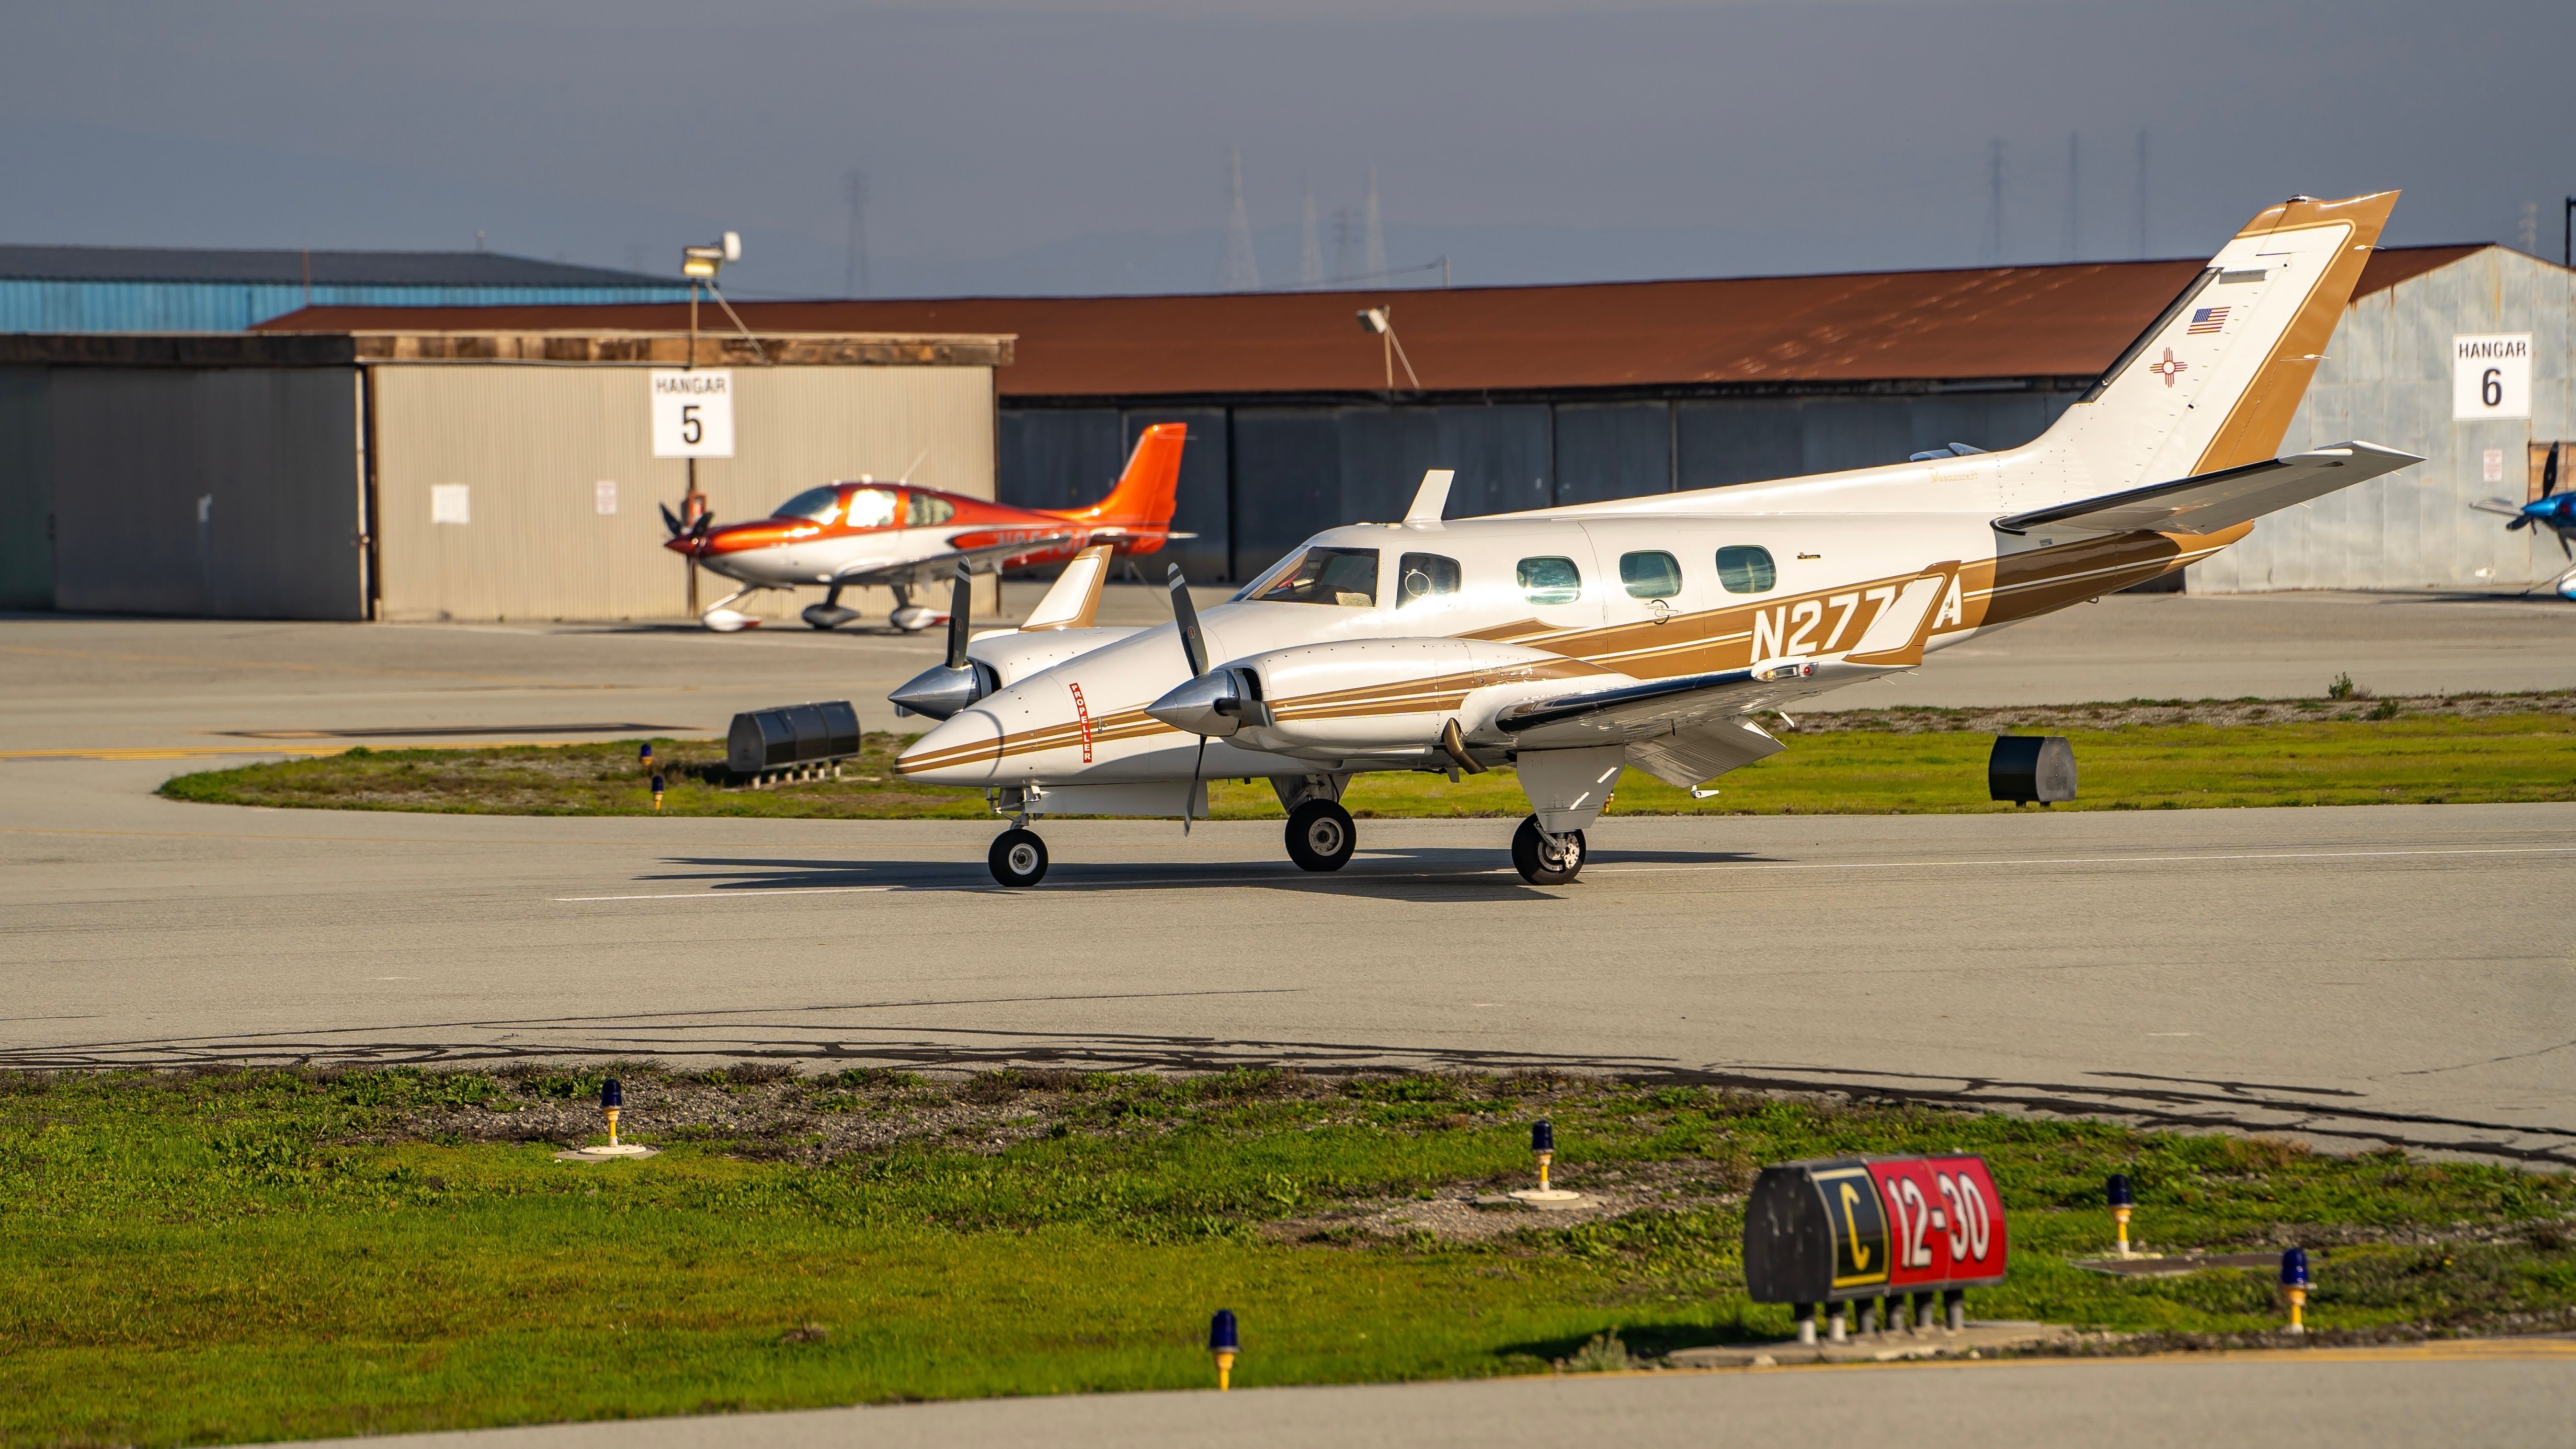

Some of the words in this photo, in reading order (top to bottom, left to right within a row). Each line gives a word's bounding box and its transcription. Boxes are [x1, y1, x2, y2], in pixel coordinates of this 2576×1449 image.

[2459, 342, 2526, 358] HANGAR
[656, 376, 726, 394] HANGAR
[2482, 368, 2502, 406] 6
[683, 405, 702, 444] 5
[1749, 573, 1962, 664] N277A
[1071, 685, 1091, 760] PROPELLER
[1839, 1181, 1870, 1271] C
[1886, 1171, 1990, 1268] 12-30
